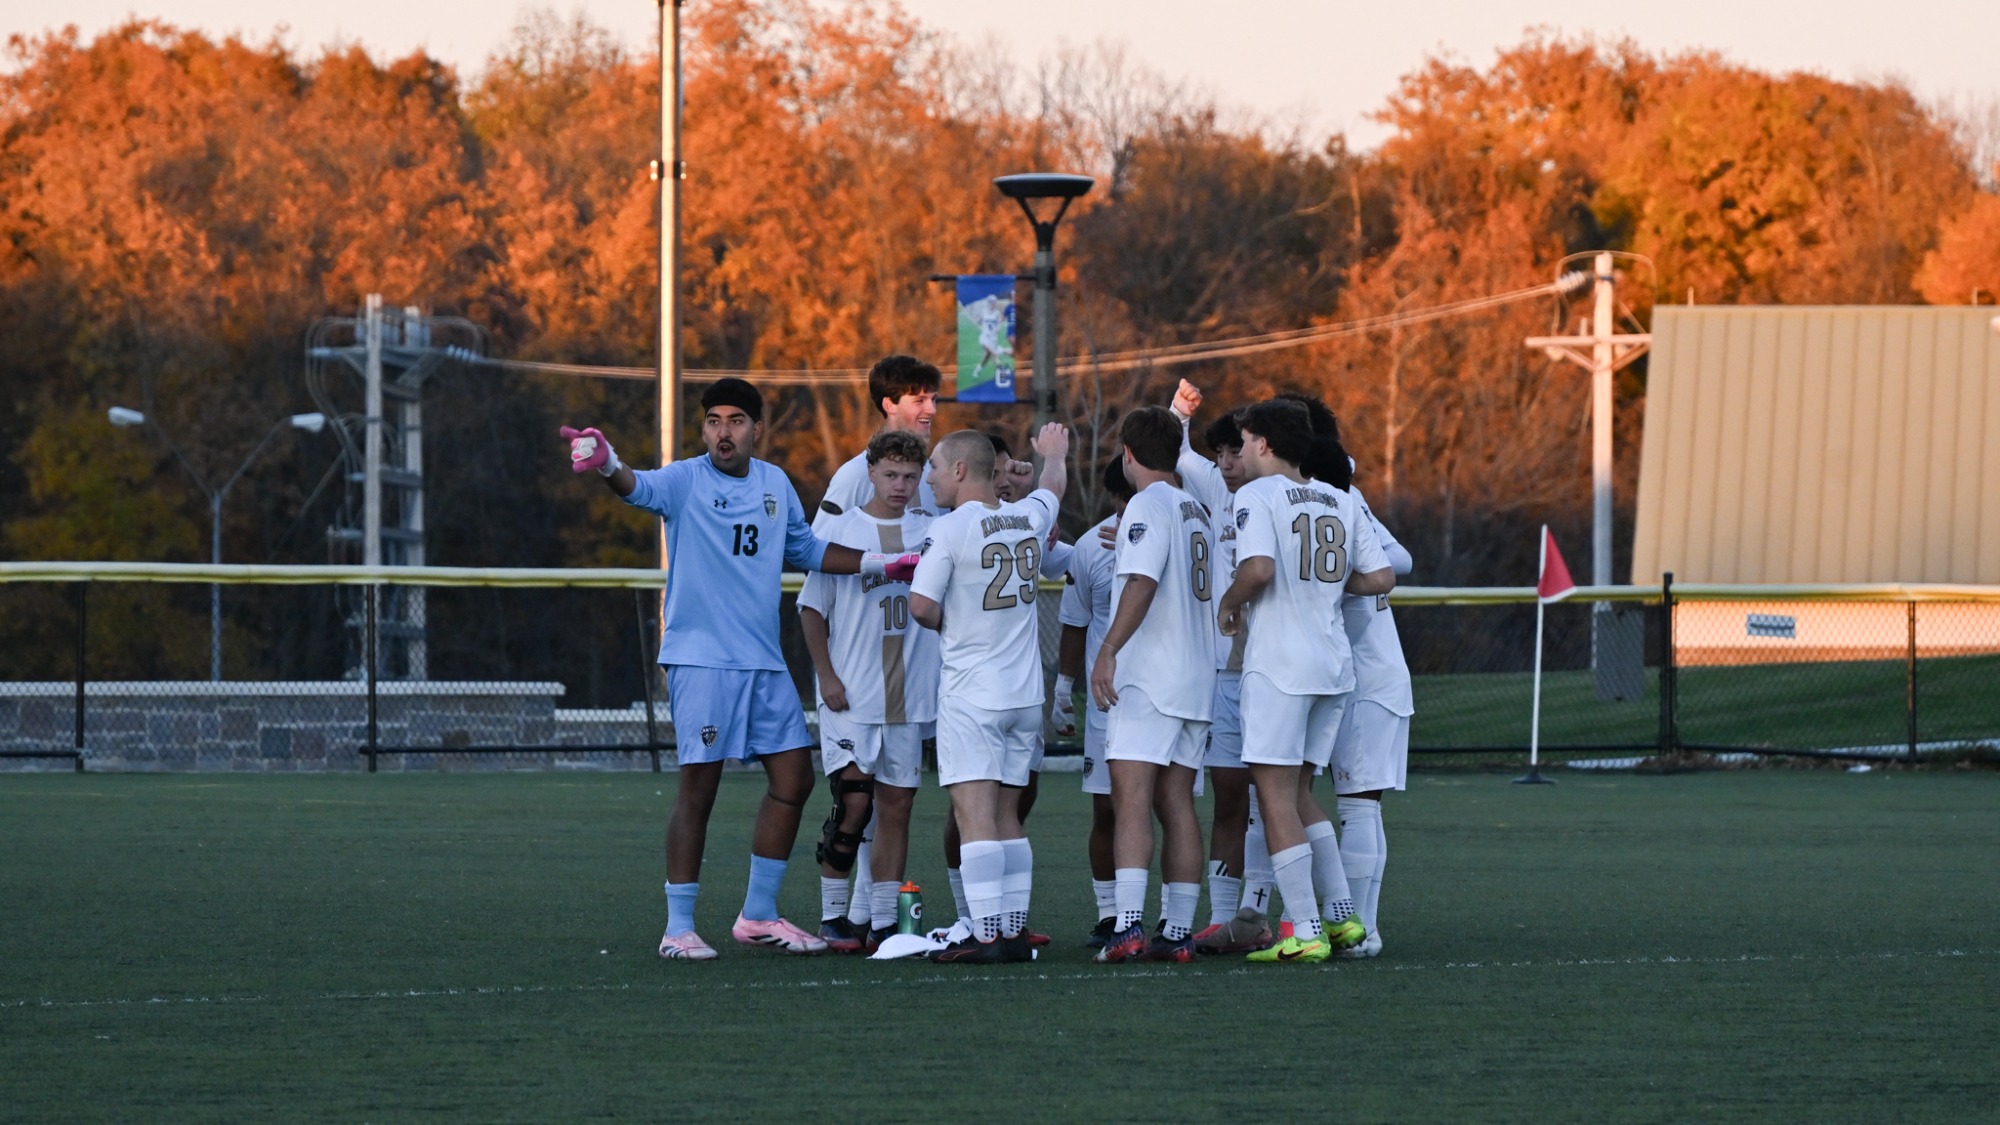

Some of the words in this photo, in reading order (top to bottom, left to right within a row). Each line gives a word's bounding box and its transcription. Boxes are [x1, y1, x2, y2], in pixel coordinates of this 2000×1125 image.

[733, 524, 759, 556] 13
[981, 537, 1041, 611] 29
[1190, 531, 1212, 602] 8
[1292, 512, 1347, 583] 18
[879, 595, 908, 631] 10
